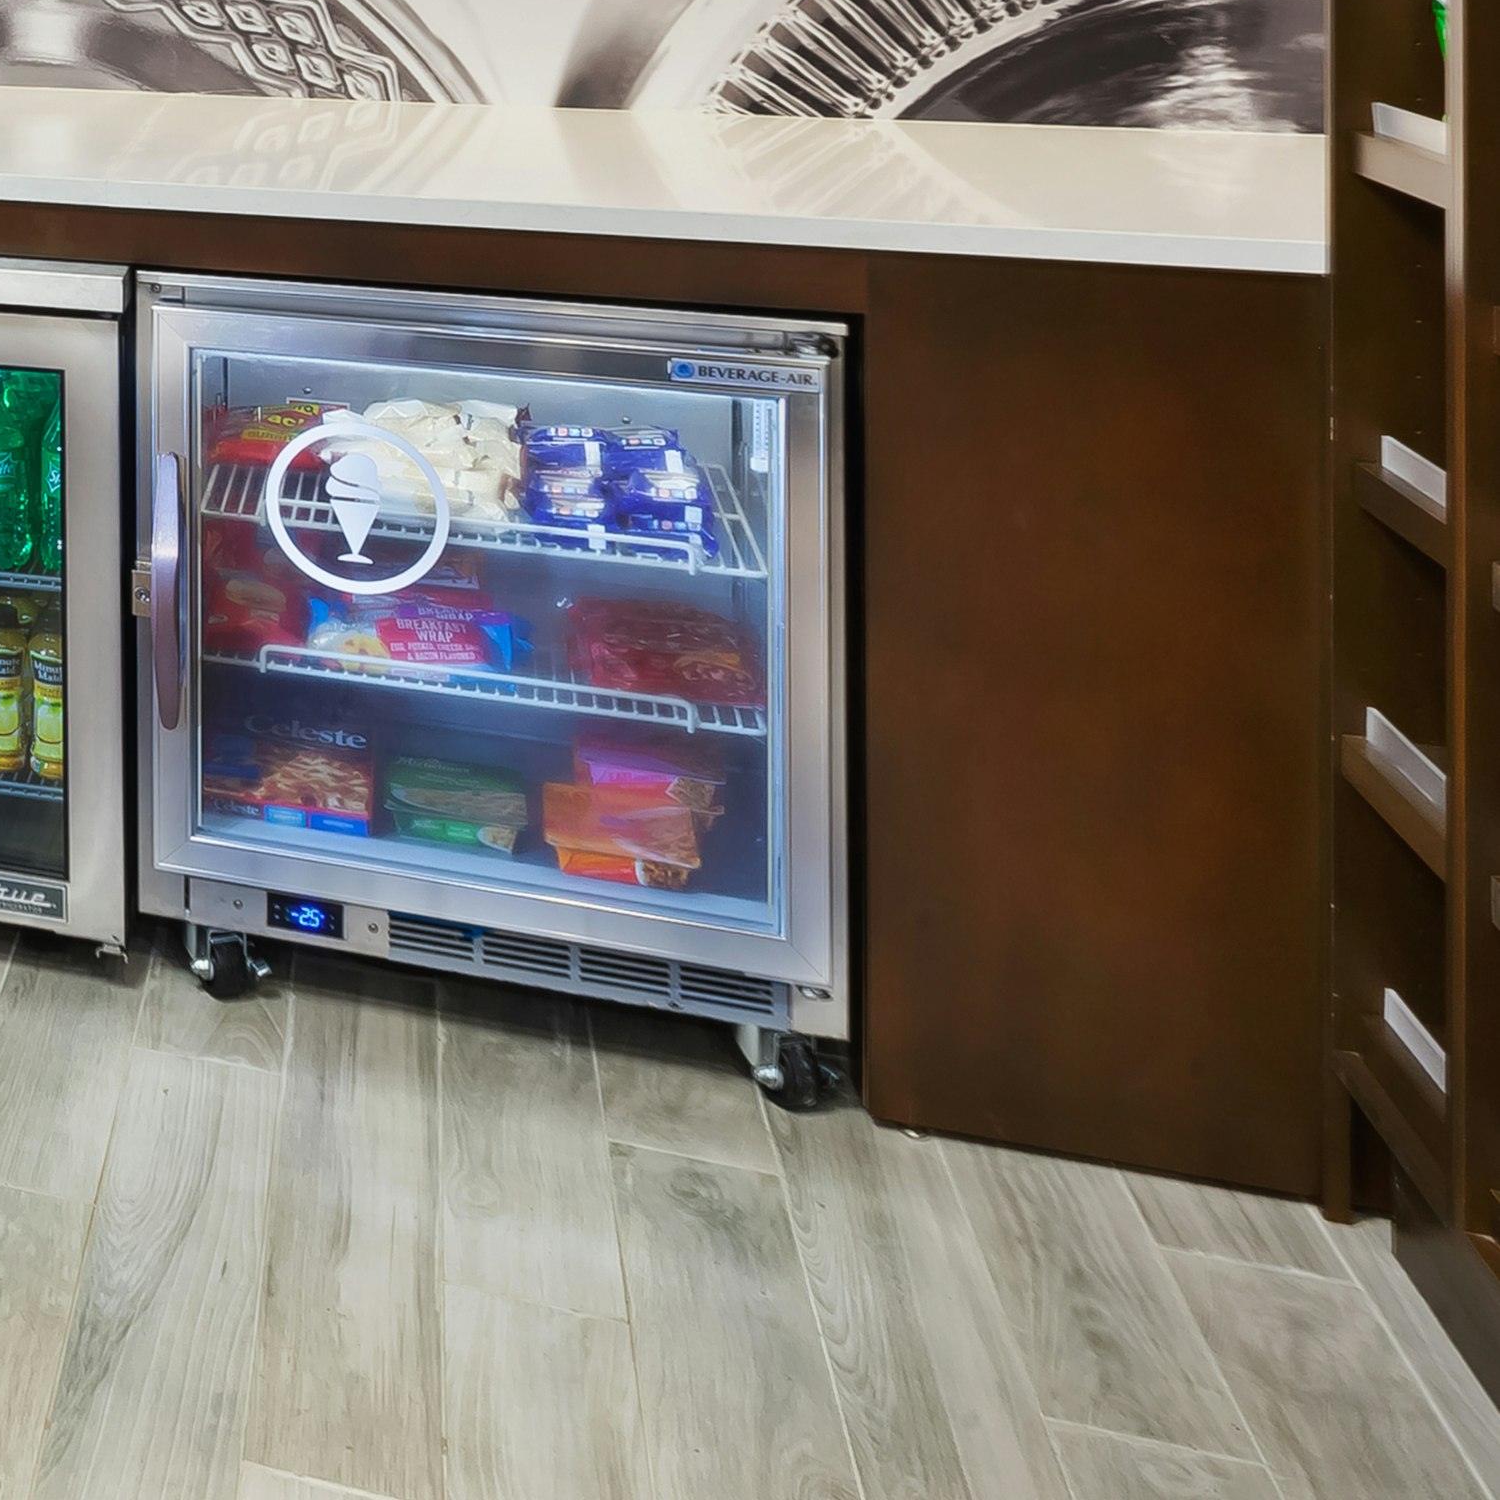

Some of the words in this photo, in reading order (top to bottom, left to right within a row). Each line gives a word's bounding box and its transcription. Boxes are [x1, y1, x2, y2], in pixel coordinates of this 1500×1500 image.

[698, 366, 814, 385] BEVERAGE-AIR
[396, 618, 467, 634] BREAKFAST
[416, 630, 454, 643] WRAP
[33, 659, 63, 673] Minut
[245, 715, 367, 749] Celeste
